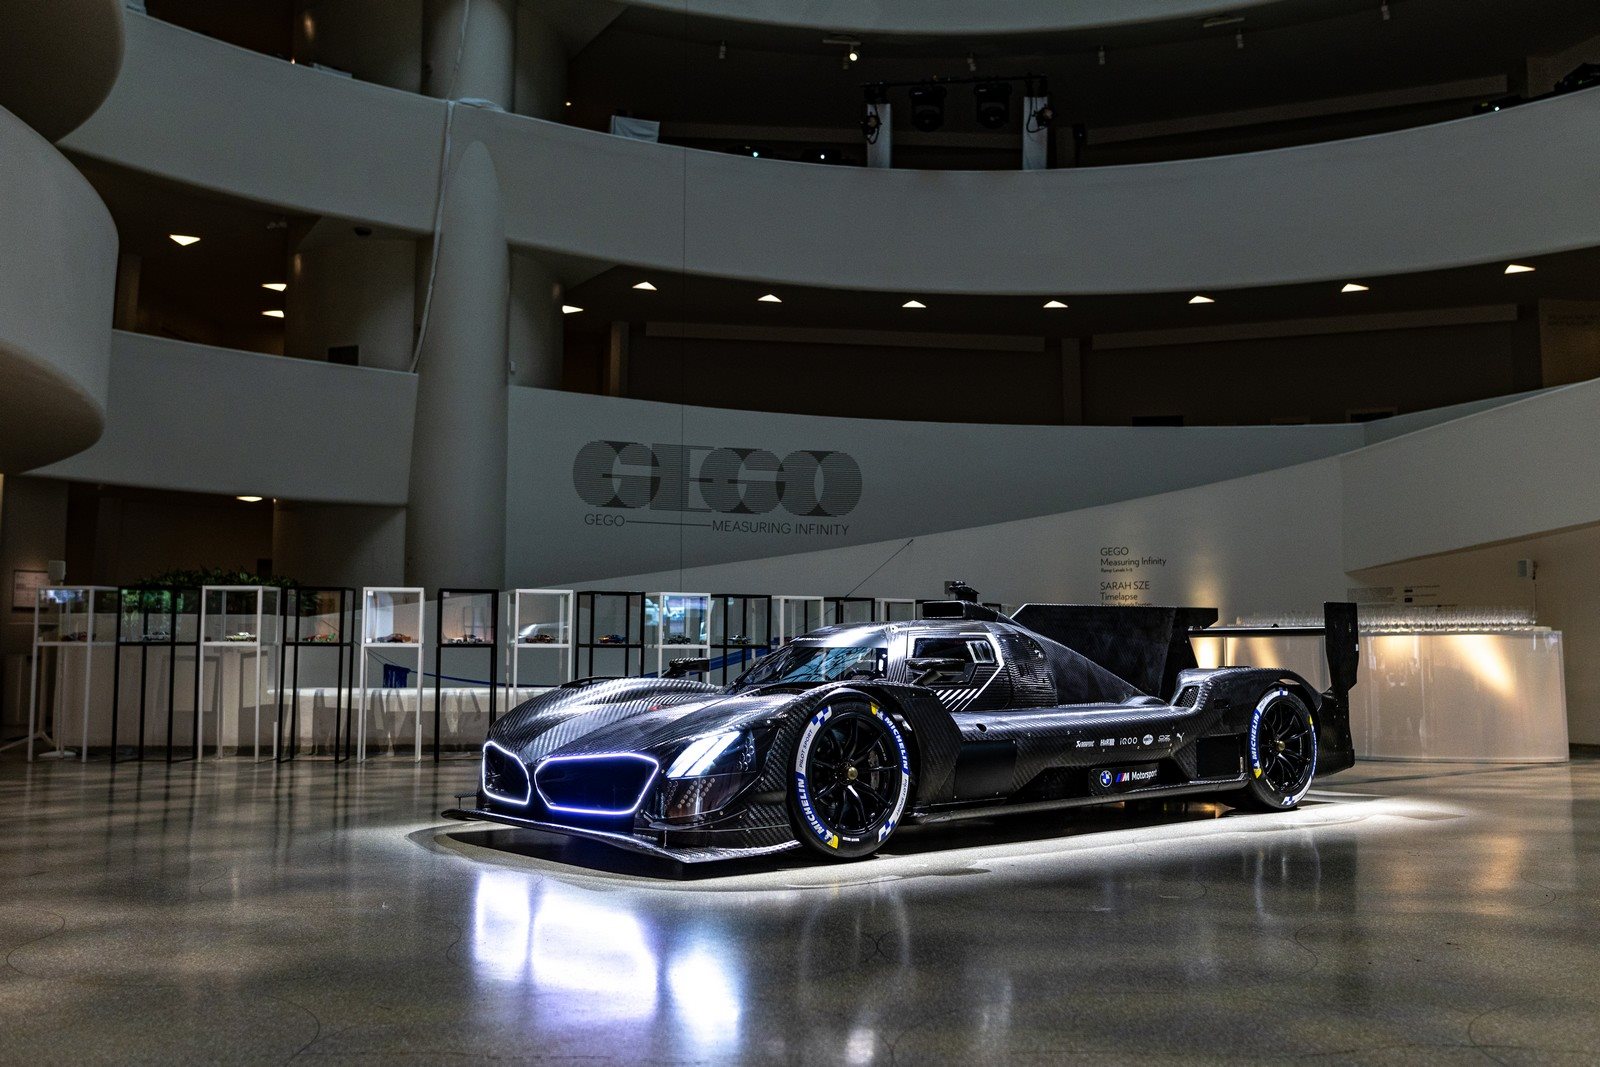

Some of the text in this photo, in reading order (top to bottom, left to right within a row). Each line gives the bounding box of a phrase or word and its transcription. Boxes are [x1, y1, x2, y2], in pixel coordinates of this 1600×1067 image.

[573, 440, 863, 518] GEGO
[584, 513, 850, 537] GEGO MEASURING INFINITY
[1100, 547, 1129, 556] GEGO
[1100, 556, 1167, 568] Measuring Infinity
[1100, 580, 1151, 591] SARAH SZE
[1100, 592, 1138, 602] Timelapse
[802, 729, 813, 749] SPORT
[884, 716, 909, 770] MICHELIN
[1250, 712, 1260, 761] MICHELIN
[1131, 769, 1158, 781] Motorsport
[797, 778, 825, 835] MICHELIN
